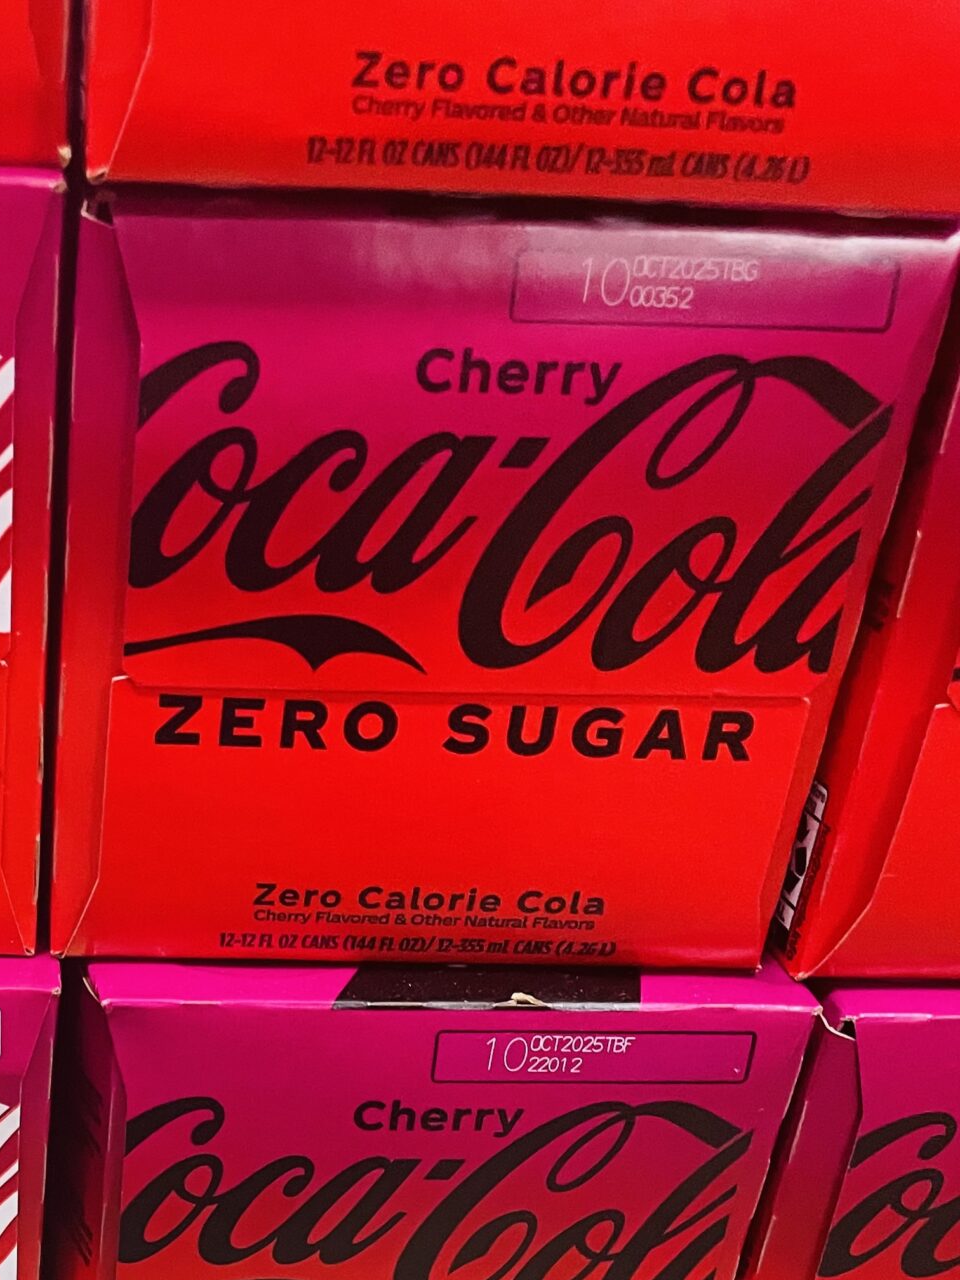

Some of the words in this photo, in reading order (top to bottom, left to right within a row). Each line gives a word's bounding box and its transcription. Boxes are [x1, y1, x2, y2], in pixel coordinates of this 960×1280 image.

[351, 50, 464, 92] Zero
[487, 55, 667, 101] Calorie
[688, 66, 797, 109] Cola
[415, 348, 623, 401] Cherry
[153, 693, 400, 753] ZERO
[442, 703, 756, 763] SUGAR
[253, 883, 341, 909] Zero
[358, 886, 501, 913] Calorie
[517, 890, 605, 916] Cola
[253, 909, 311, 924] Cherry
[315, 911, 390, 925] Flavored
[394, 914, 407, 926] &
[410, 914, 461, 927] Other
[464, 915, 528, 929] Natural
[532, 917, 595, 931] Flavors
[258, 933, 273, 948] FL
[278, 934, 298, 949] OZ
[301, 934, 338, 950] CANS
[486, 1037, 529, 1072] 10
[527, 1057, 583, 1073] 22012
[352, 1100, 525, 1138] Cherry
